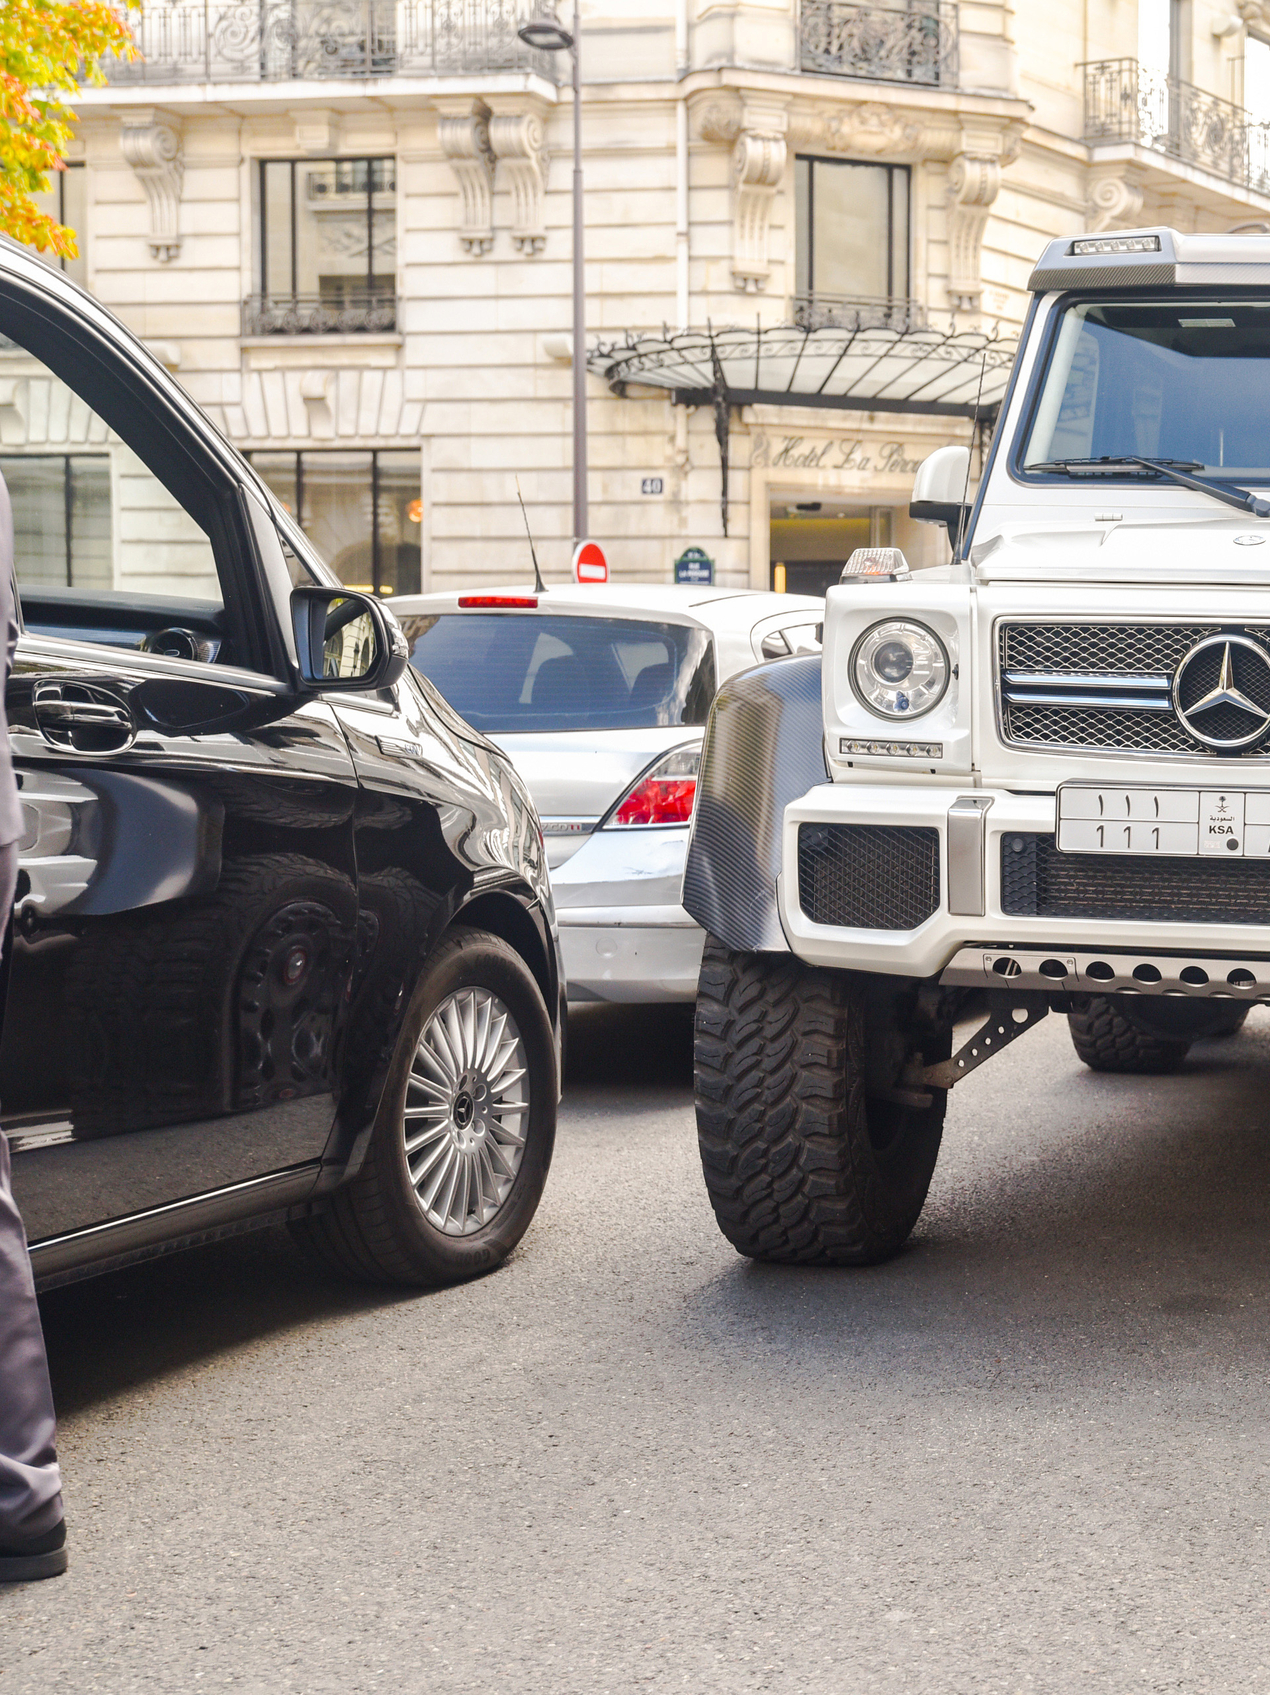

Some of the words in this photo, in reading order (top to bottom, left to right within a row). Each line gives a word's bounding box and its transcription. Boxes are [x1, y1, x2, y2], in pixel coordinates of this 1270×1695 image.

[832, 438, 872, 472] La
[643, 479, 662, 494] 40
[1208, 825, 1235, 835] KSA
